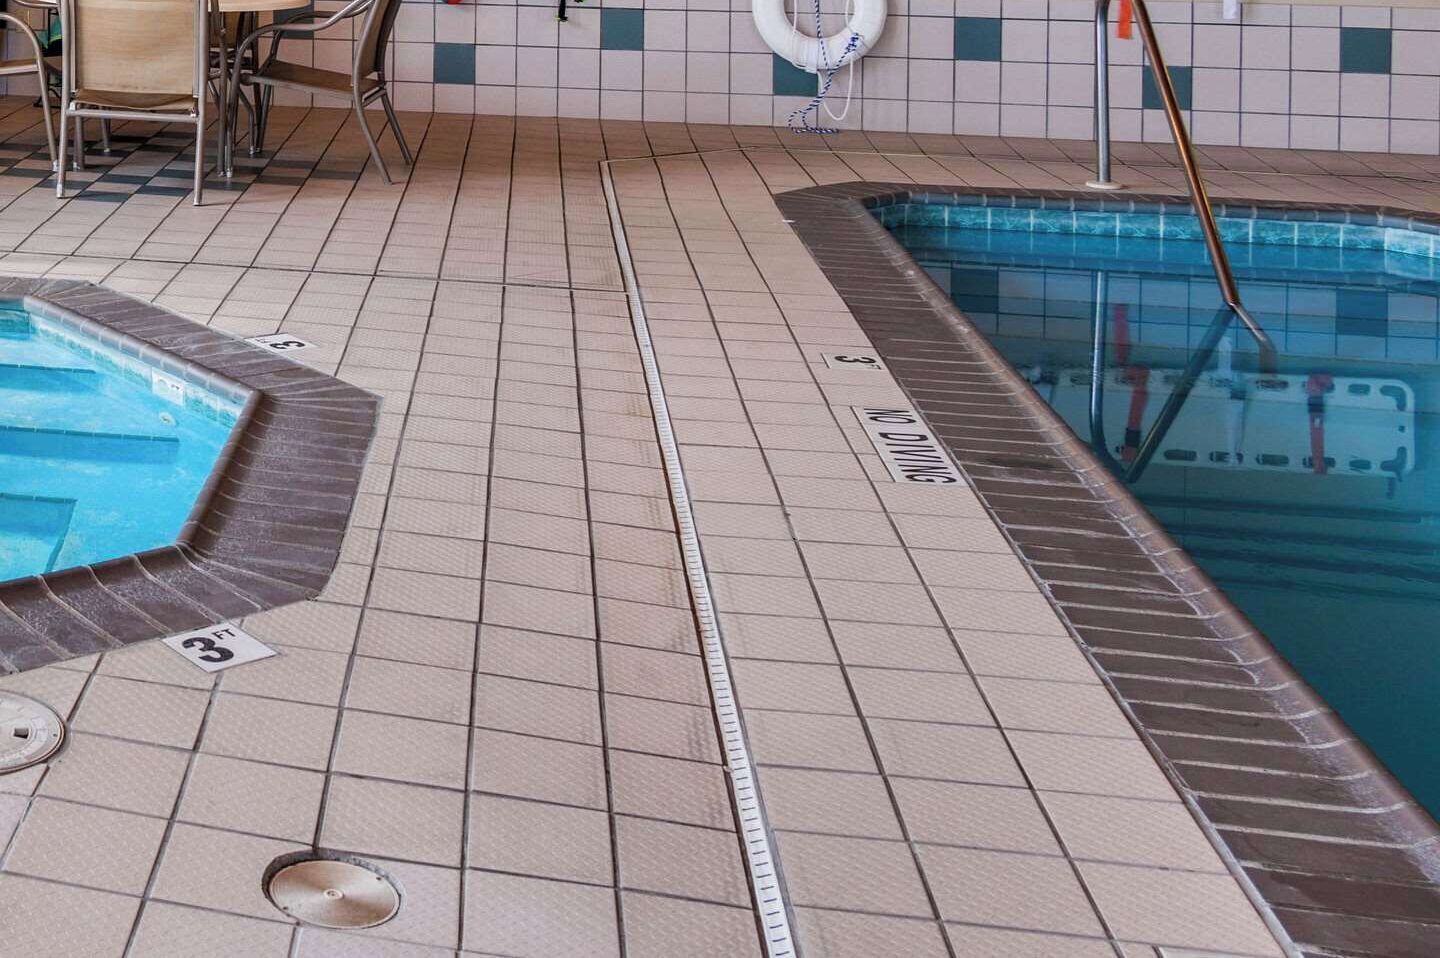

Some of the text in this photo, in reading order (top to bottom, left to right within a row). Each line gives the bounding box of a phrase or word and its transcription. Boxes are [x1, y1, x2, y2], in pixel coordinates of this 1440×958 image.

[269, 341, 305, 349] 3
[835, 355, 876, 364] 3
[863, 408, 957, 483] NO DIVING
[182, 628, 236, 662] 3 FT
